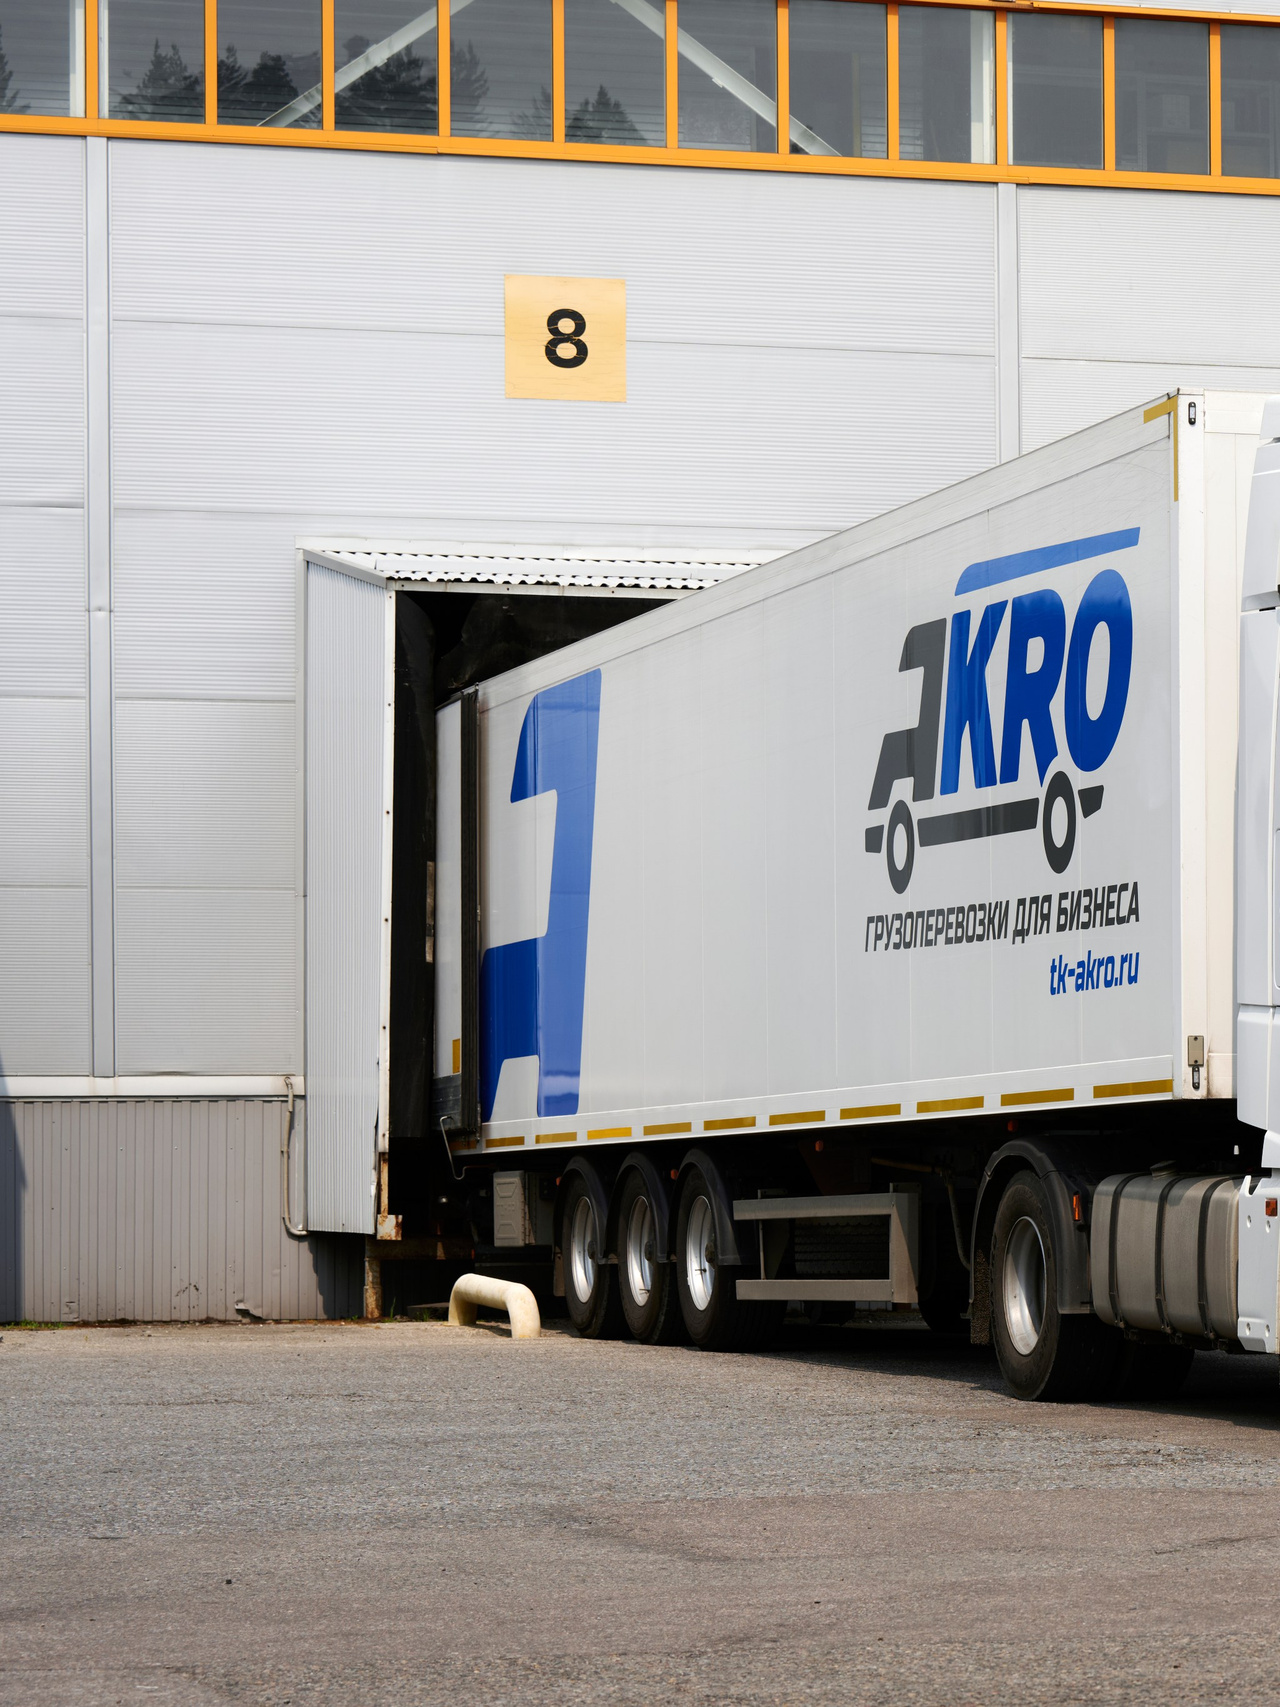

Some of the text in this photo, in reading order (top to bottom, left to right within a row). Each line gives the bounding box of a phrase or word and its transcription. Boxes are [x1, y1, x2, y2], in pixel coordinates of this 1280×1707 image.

[544, 308, 588, 369] 8
[864, 881, 1140, 952] ГРУЗОПЕРЕВОЗКИ ДЛЯ БИЗНЕСА
[1050, 950, 1140, 996] tk-akro.ru
